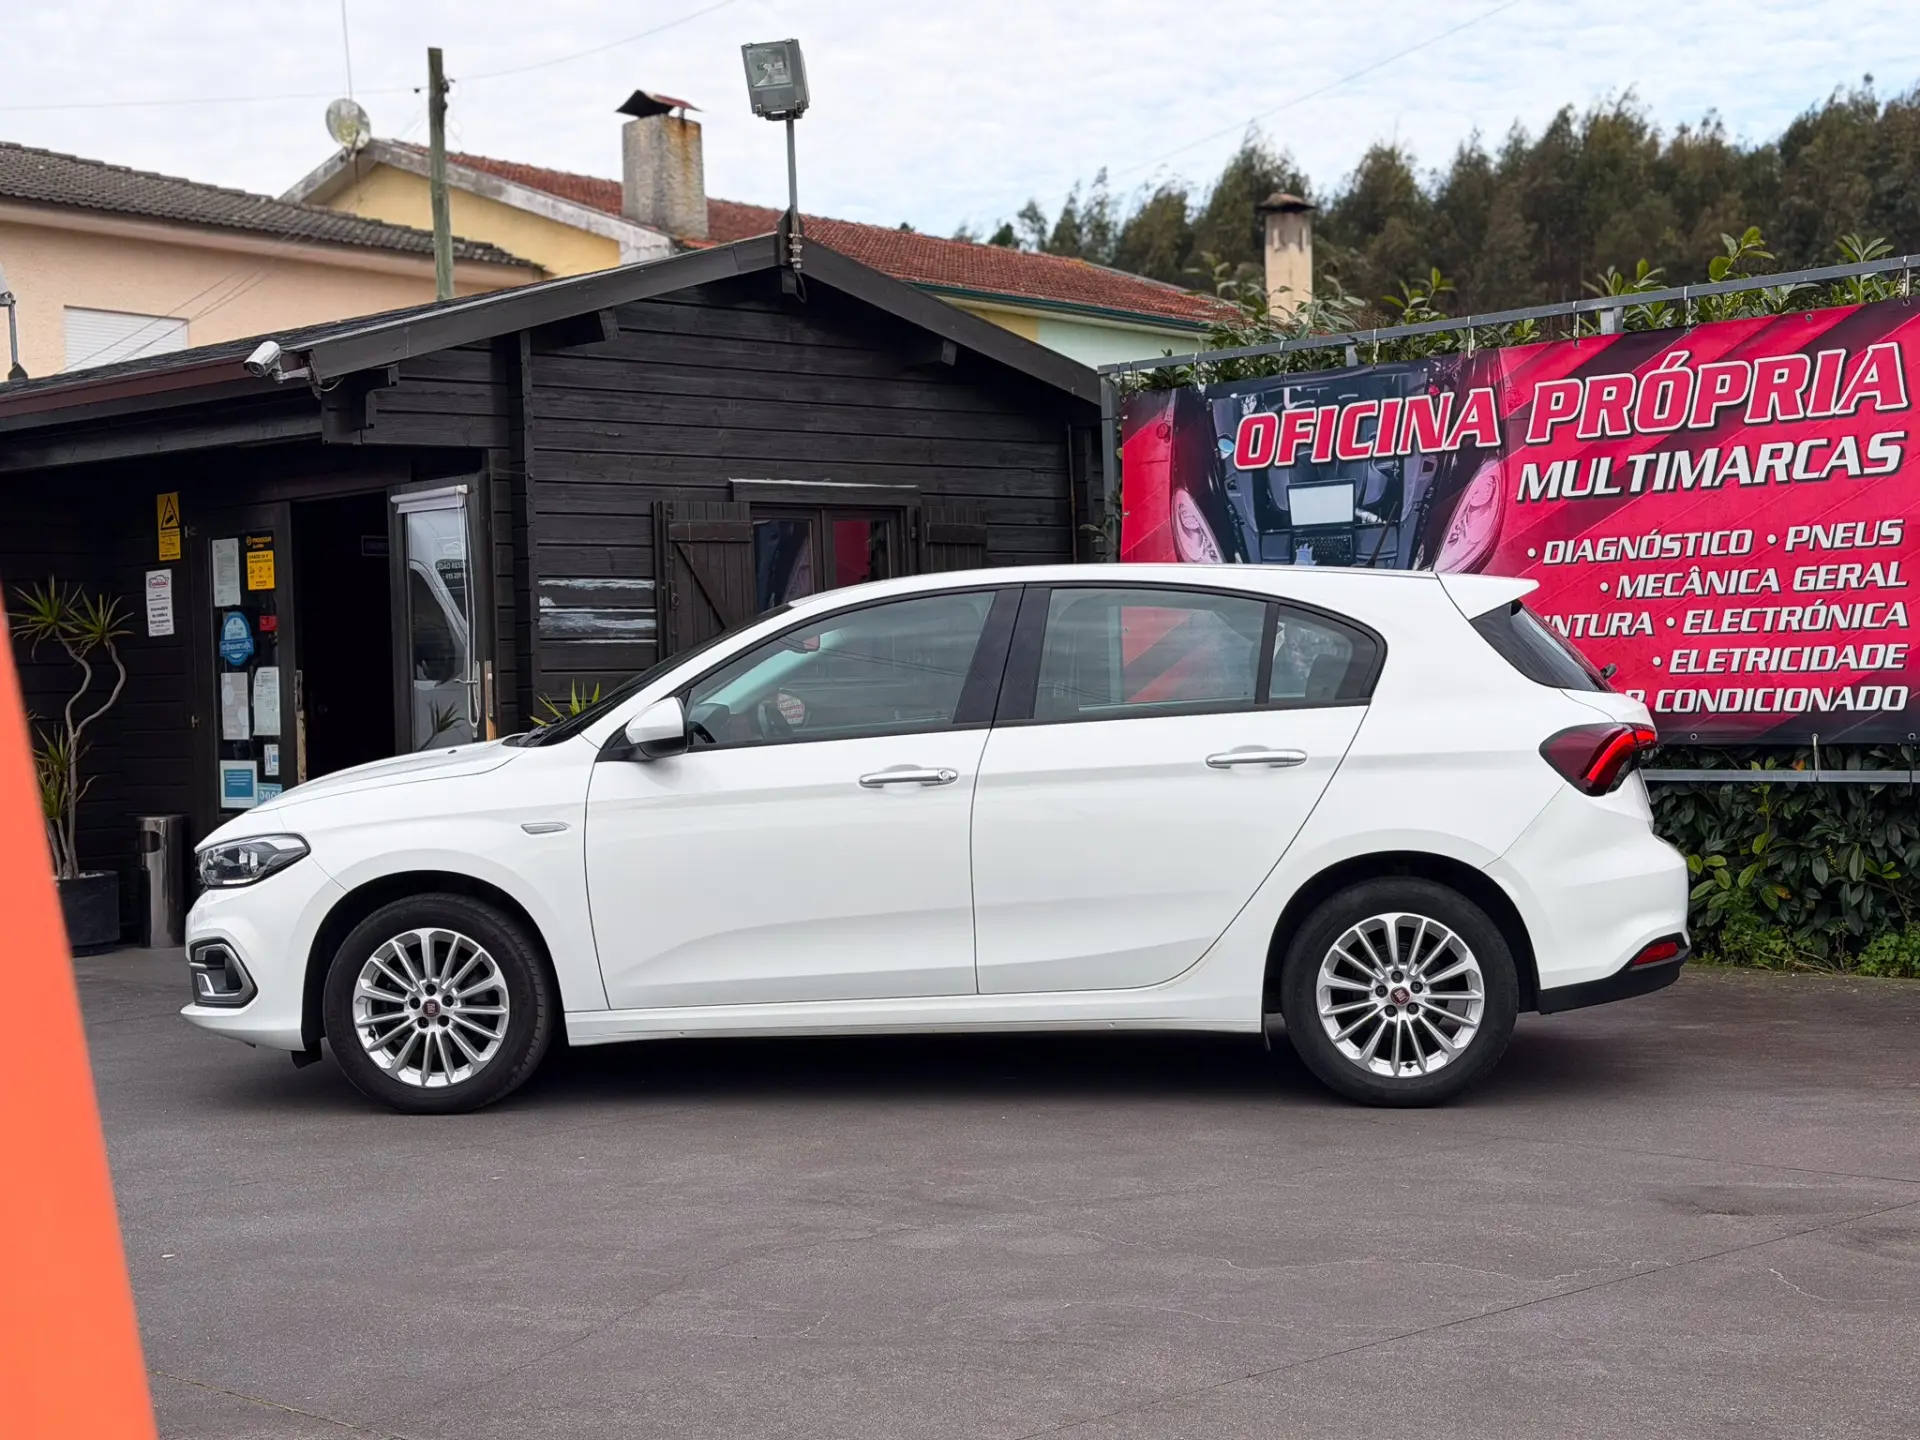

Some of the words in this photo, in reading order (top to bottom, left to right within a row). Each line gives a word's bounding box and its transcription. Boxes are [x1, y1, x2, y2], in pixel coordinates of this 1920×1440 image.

[1233, 387, 1502, 471] OFICINA
[1525, 341, 1909, 445] PRÓPRIA
[1516, 431, 1905, 501] MULTIMARCAS
[1543, 529, 1753, 565] DIAGNÓSTICO
[1785, 519, 1904, 552] PNEUS
[1616, 566, 1780, 599] MECÂNICA
[1793, 561, 1907, 592] GERAL
[1682, 601, 1908, 634] ELECTRÓNICA
[1669, 643, 1909, 674] ELETRICIDADE
[1654, 685, 1909, 714] CONDICIONADO
